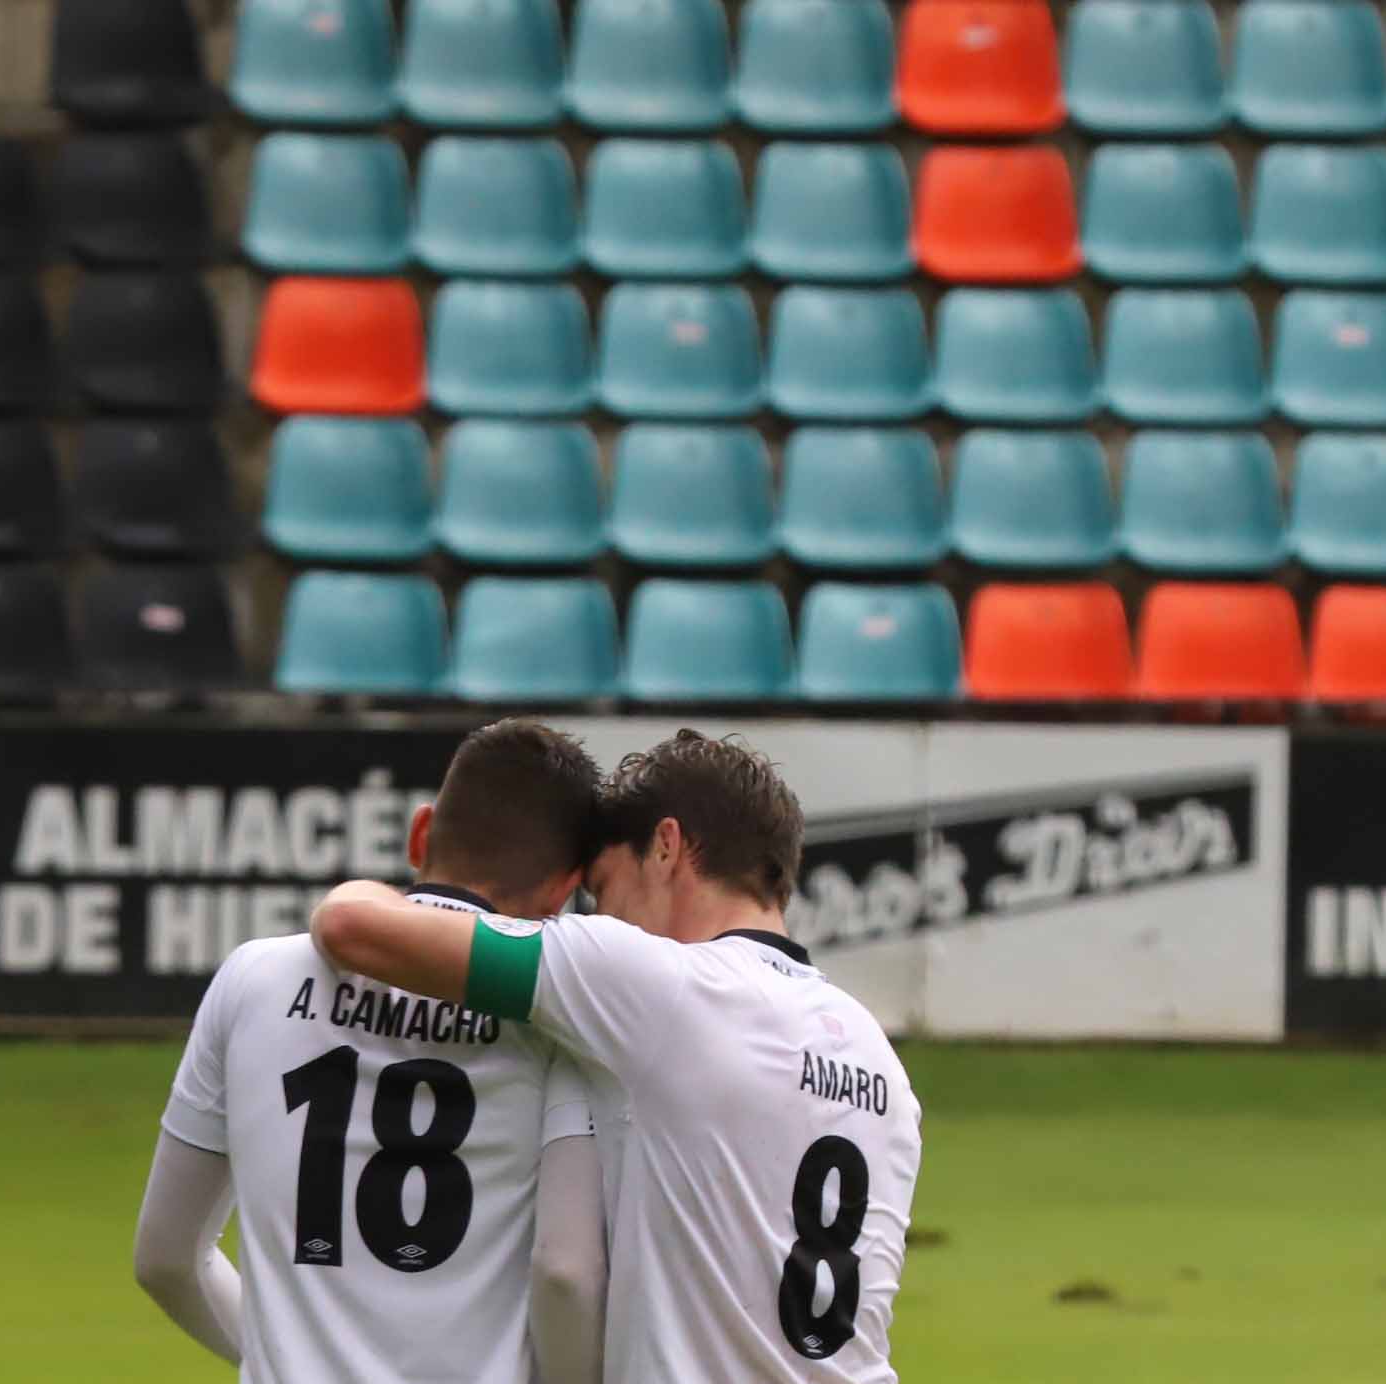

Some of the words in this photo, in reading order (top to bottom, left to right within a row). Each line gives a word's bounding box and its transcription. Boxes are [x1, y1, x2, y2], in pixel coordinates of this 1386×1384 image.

[15, 770, 435, 878] ALMACÉ
[286, 976, 316, 1020] A.
[330, 982, 500, 1045] CAMACHO
[799, 1050, 888, 1117] AMARO
[282, 1044, 476, 1273] 18
[778, 1135, 869, 1360] 8
